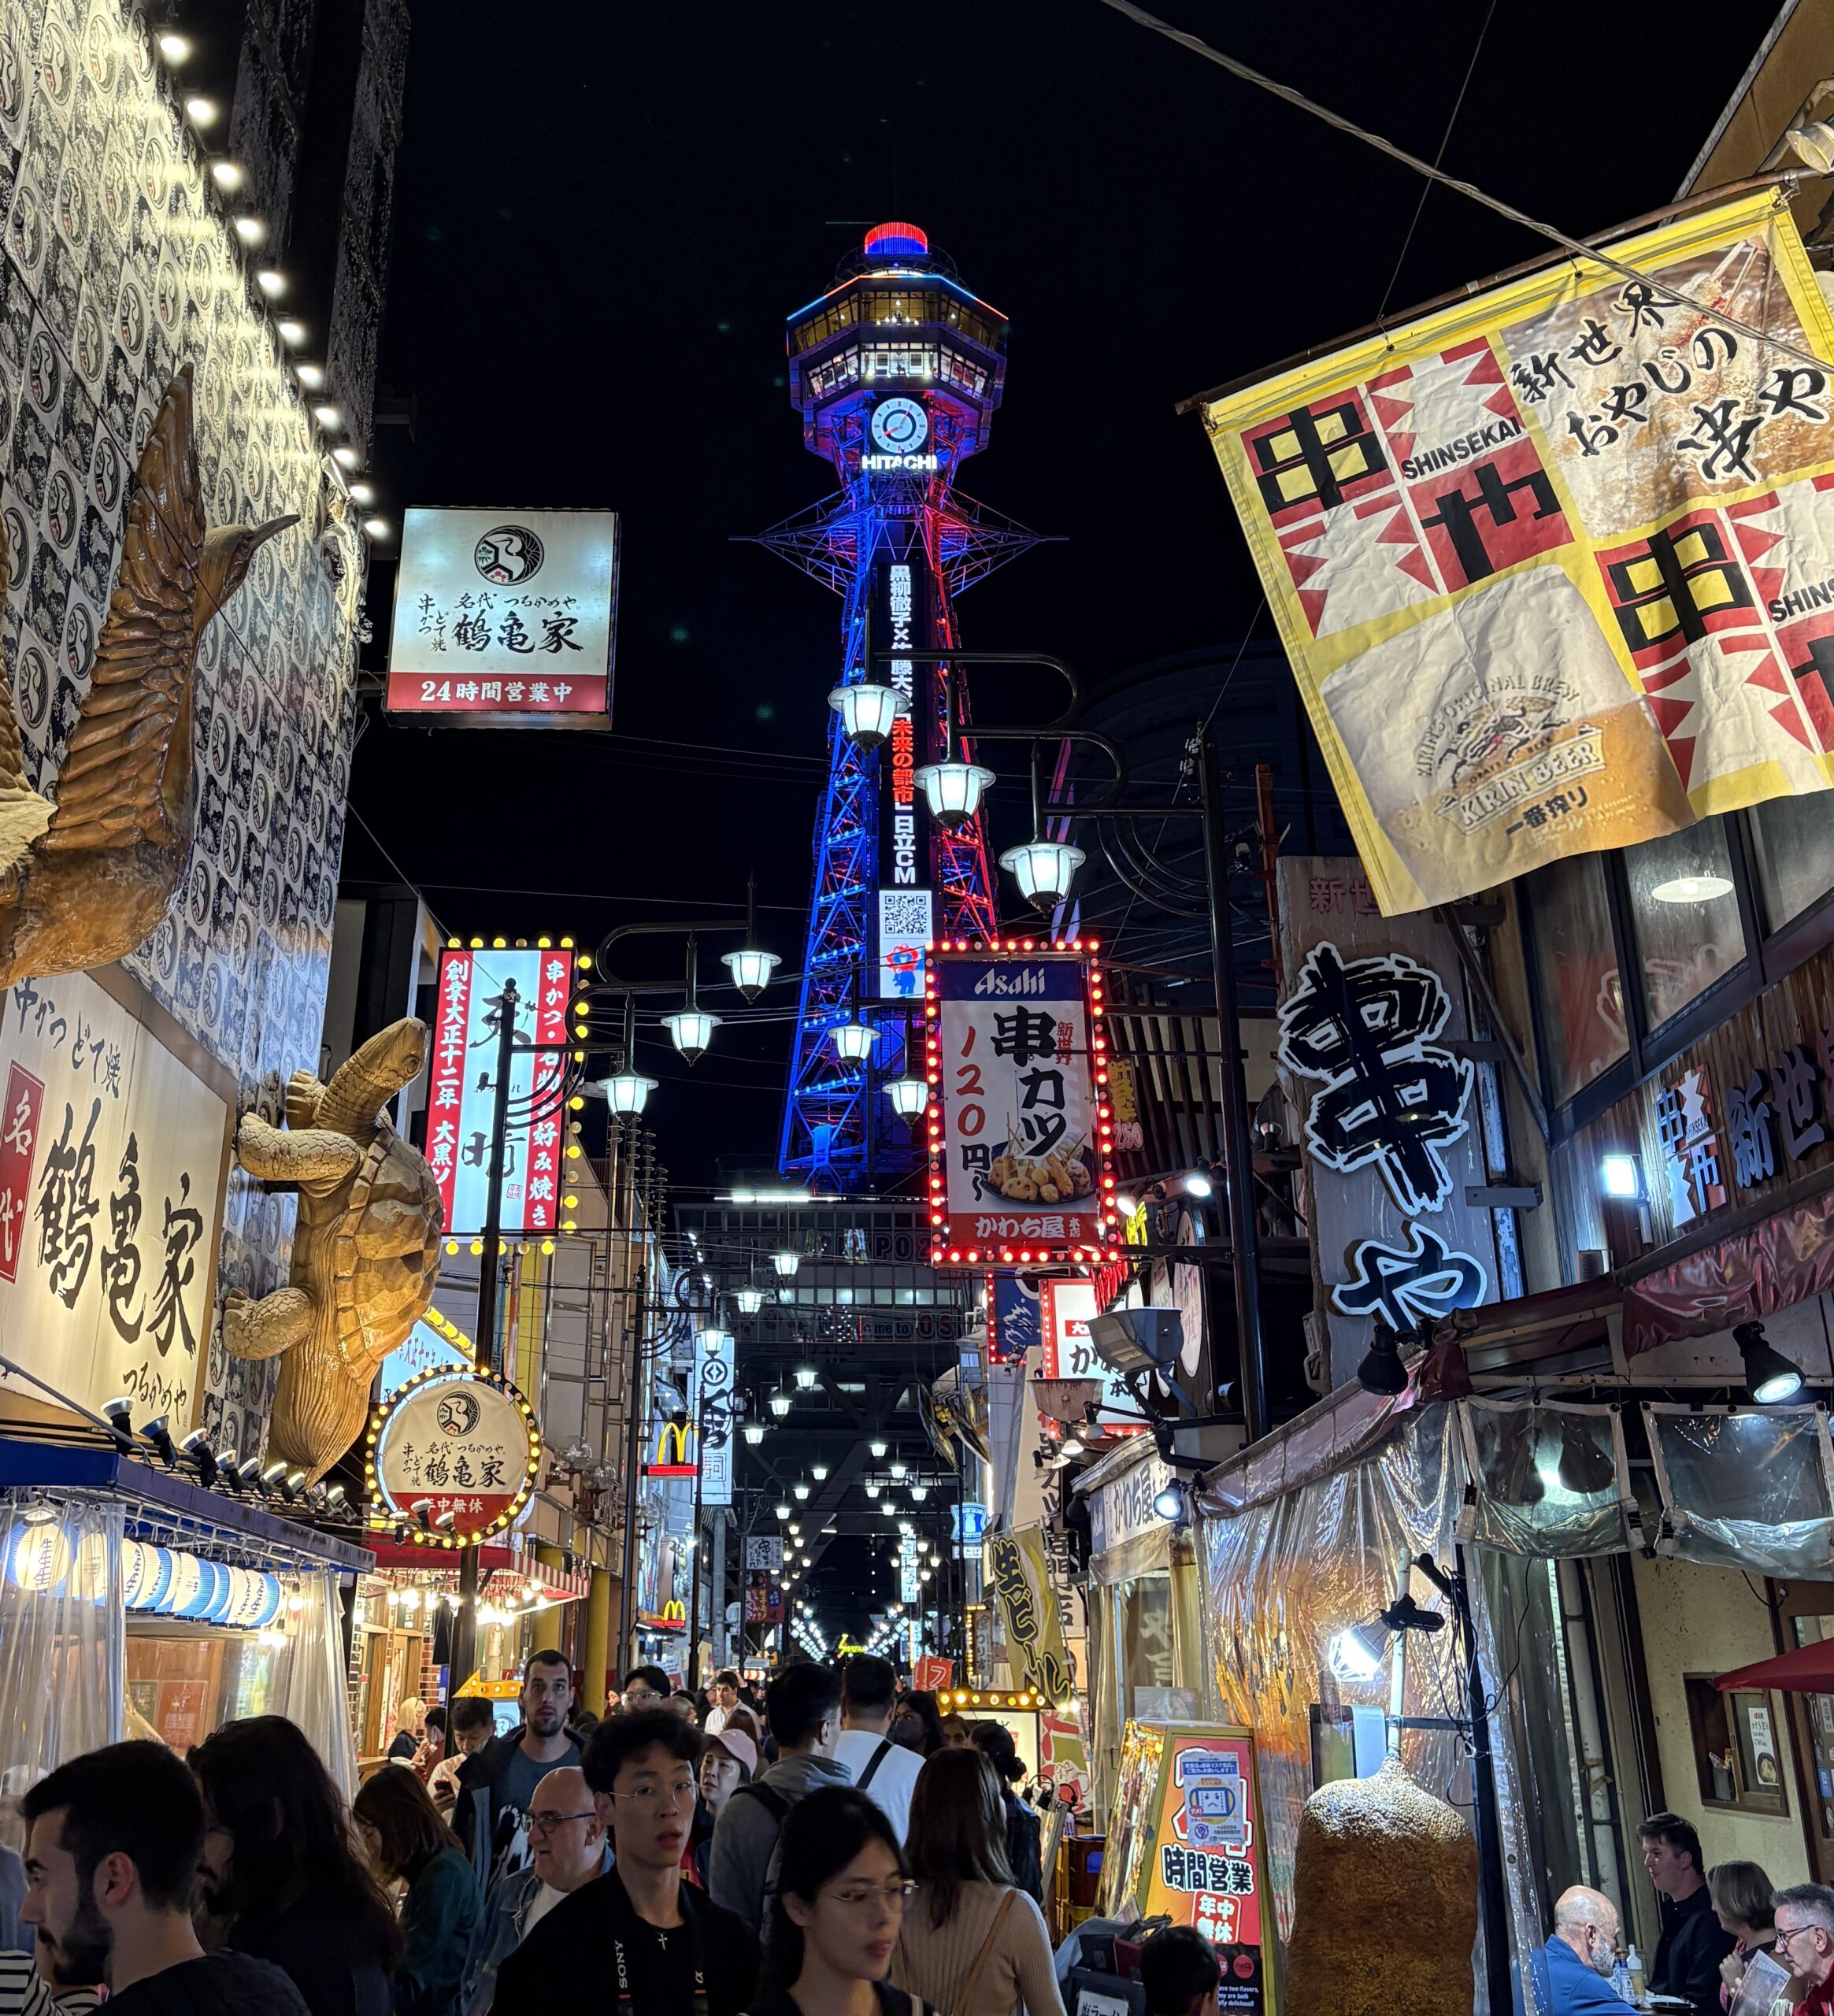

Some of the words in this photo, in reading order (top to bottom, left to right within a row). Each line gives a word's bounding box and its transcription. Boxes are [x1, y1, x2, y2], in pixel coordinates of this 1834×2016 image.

[1567, 328, 1738, 457] おやじの
[861, 454, 938, 471] HITACHI
[1401, 417, 1522, 480] SHINSEKAI
[451, 609, 584, 654] 鶴亀家
[420, 680, 573, 703] 24時間営業中
[1460, 770, 1530, 825] KIRIN
[1534, 742, 1600, 785] BEER
[1506, 786, 1588, 836] 一番搾り
[973, 967, 1046, 996] Asahi
[435, 958, 470, 1110] 創業大正十二年
[1055, 1021, 1075, 1066] 新世界
[990, 1006, 1068, 1158] 串カツ
[35, 1097, 204, 1361] 鶴亀家
[974, 1215, 1065, 1239] かわち屋
[1069, 1217, 1081, 1238] 本店
[424, 1453, 507, 1488] 鶴亀家
[1163, 1846, 1254, 1894] 時間営業
[1199, 1895, 1235, 1920] 年中
[615, 1940, 628, 1989] SONY
